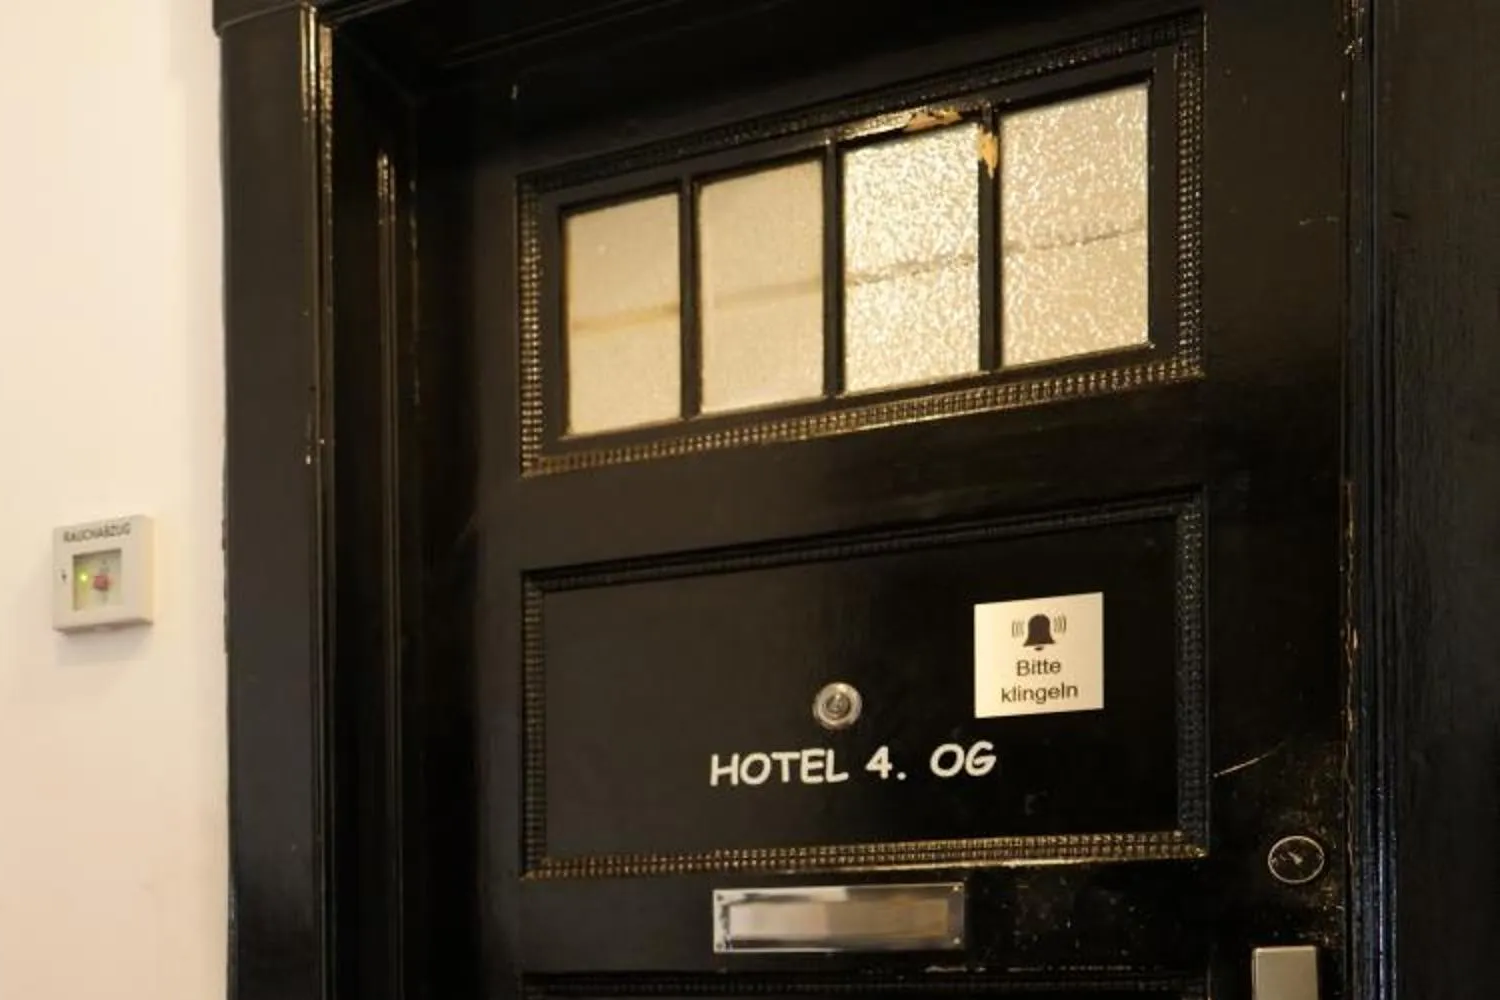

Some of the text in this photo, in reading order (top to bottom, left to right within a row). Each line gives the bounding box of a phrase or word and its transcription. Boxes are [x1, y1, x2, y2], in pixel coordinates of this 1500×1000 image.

[1015, 659, 1062, 677] Bitte
[1000, 682, 1080, 704] klingeln
[708, 740, 998, 788] HOTEL 4. OG
